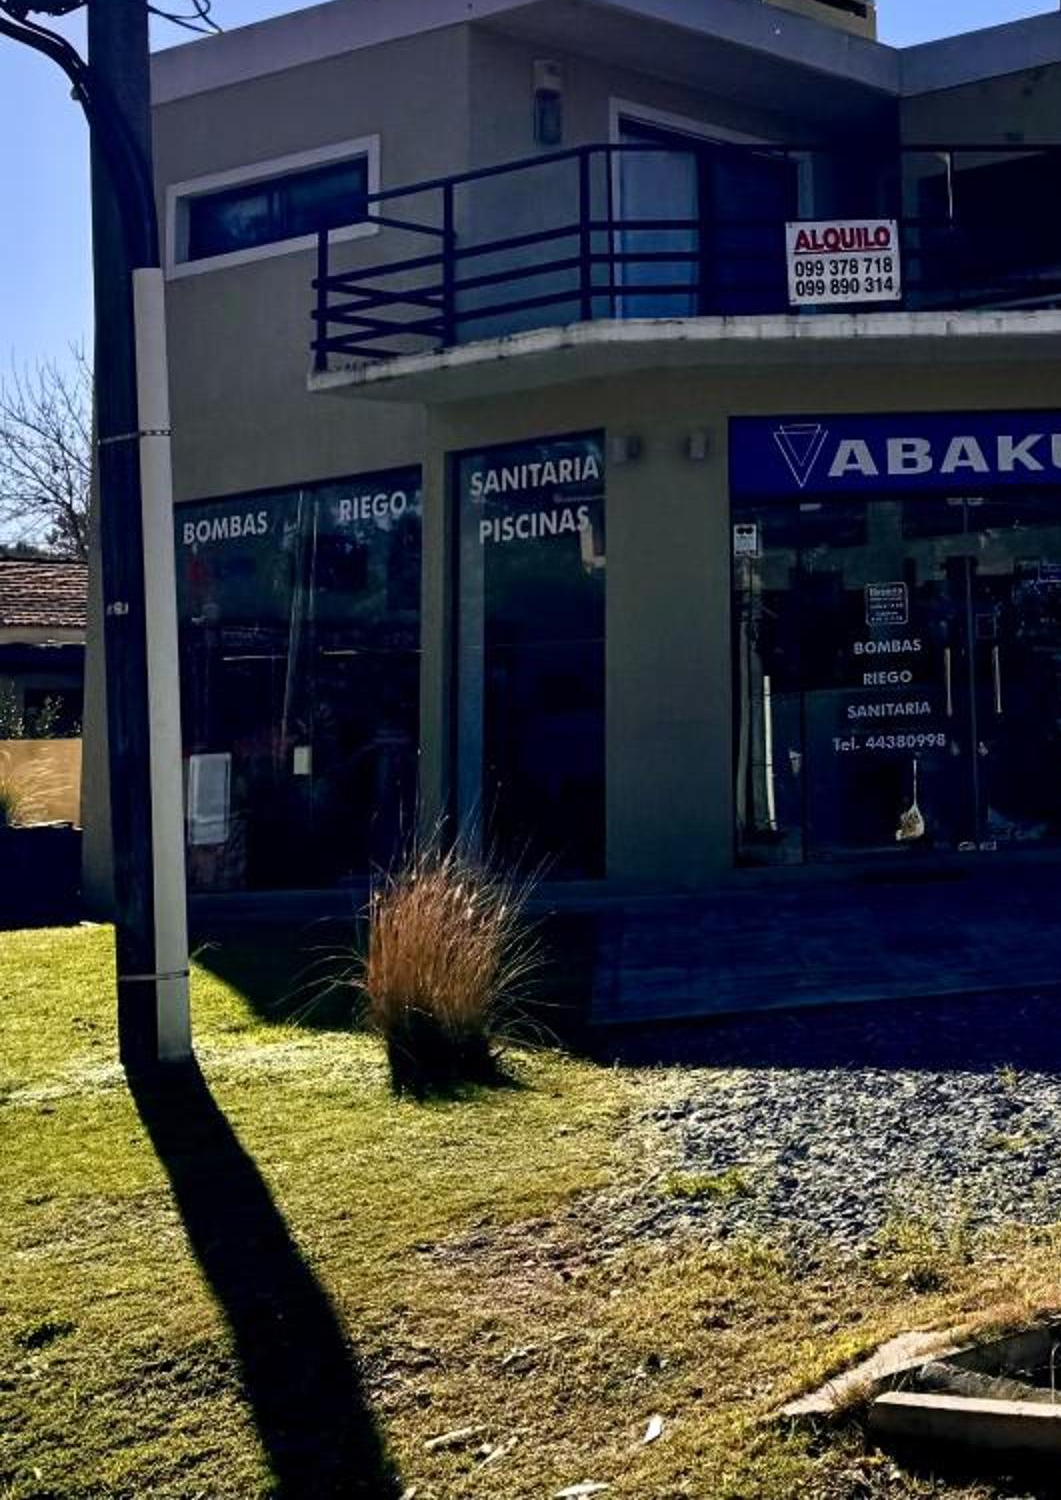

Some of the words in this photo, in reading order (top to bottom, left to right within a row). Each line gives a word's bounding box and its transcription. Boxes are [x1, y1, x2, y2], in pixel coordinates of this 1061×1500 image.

[795, 226, 891, 251] ALQUILO
[795, 260, 824, 277] 099
[829, 259, 859, 275] 378
[864, 257, 893, 273] 718
[796, 279, 825, 296] 099
[830, 278, 859, 295] 890
[865, 276, 893, 293] 314
[469, 454, 600, 498] SANITARIA
[337, 490, 408, 522] RIEGO
[182, 510, 269, 545] BOMBAS
[479, 505, 591, 545] PISCINAS
[852, 638, 924, 656] BOMBAS
[862, 668, 913, 687] RIEGO
[847, 701, 932, 719] SANITARIA
[832, 735, 861, 752] Tel.
